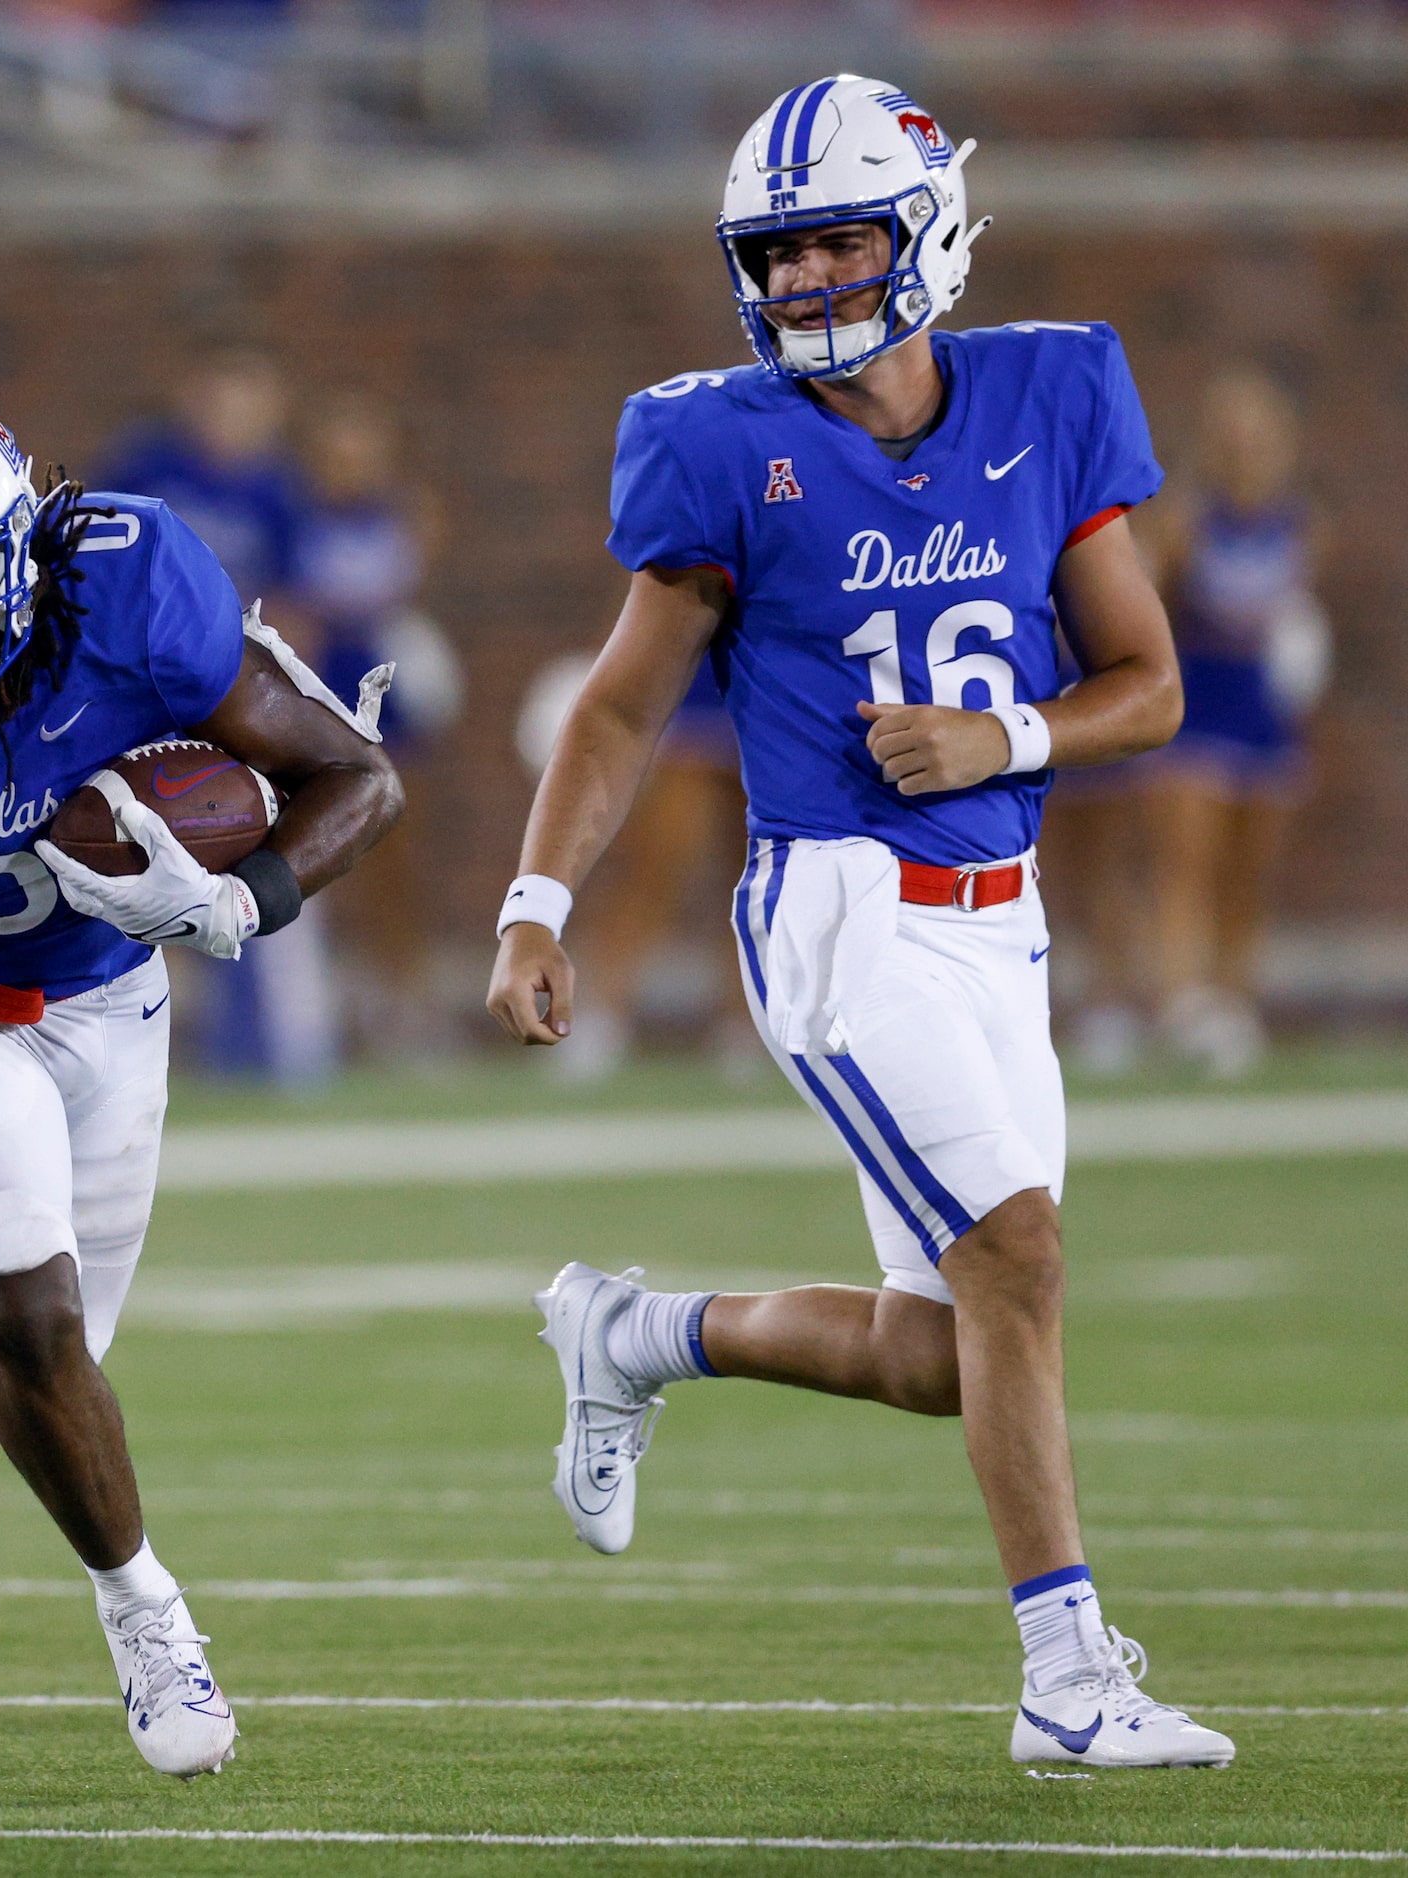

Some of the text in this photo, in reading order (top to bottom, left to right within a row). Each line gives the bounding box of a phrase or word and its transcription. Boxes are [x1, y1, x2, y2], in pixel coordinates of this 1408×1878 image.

[770, 190, 797, 211] 214
[62, 513, 141, 552] 0
[841, 520, 1007, 592] Dallas
[842, 599, 1015, 712] 16
